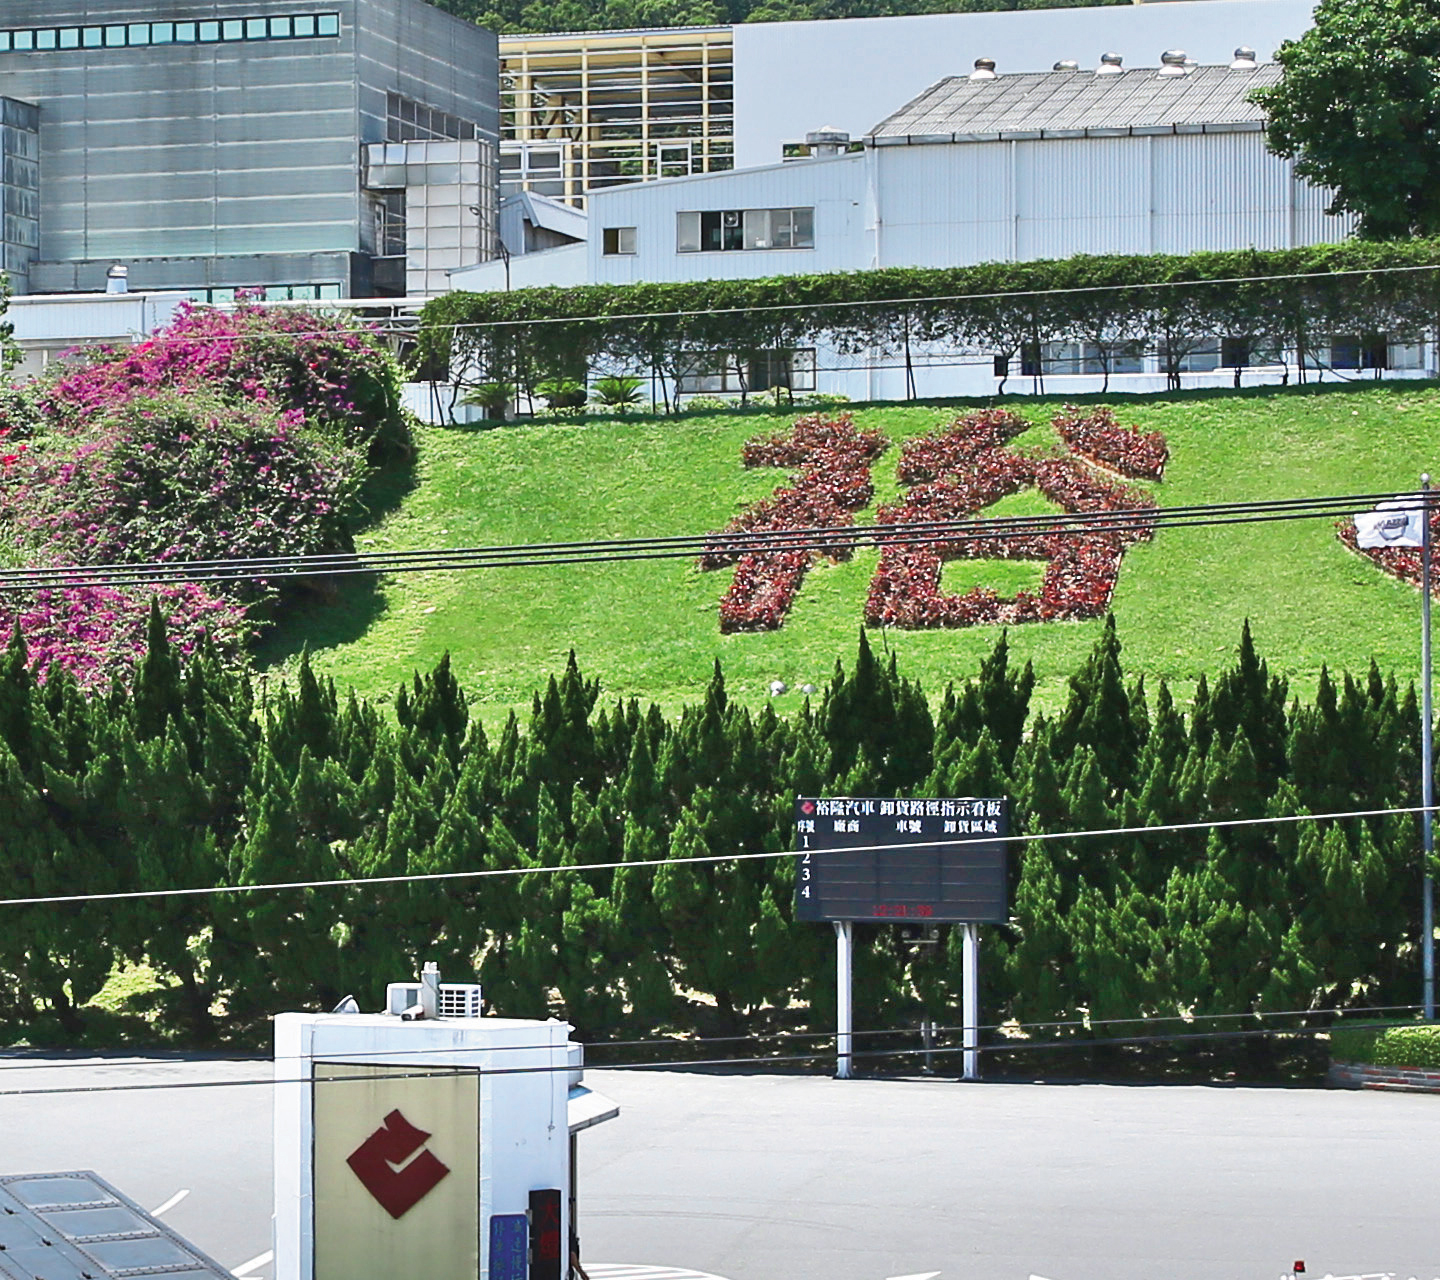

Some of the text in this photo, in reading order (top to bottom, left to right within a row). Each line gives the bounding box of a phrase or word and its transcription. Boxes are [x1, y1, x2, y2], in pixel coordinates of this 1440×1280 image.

[816, 800, 875, 816] 裕隆汽車
[803, 835, 809, 848] 1
[802, 851, 811, 864] 2
[802, 867, 811, 881] 3
[801, 885, 811, 898] 4
